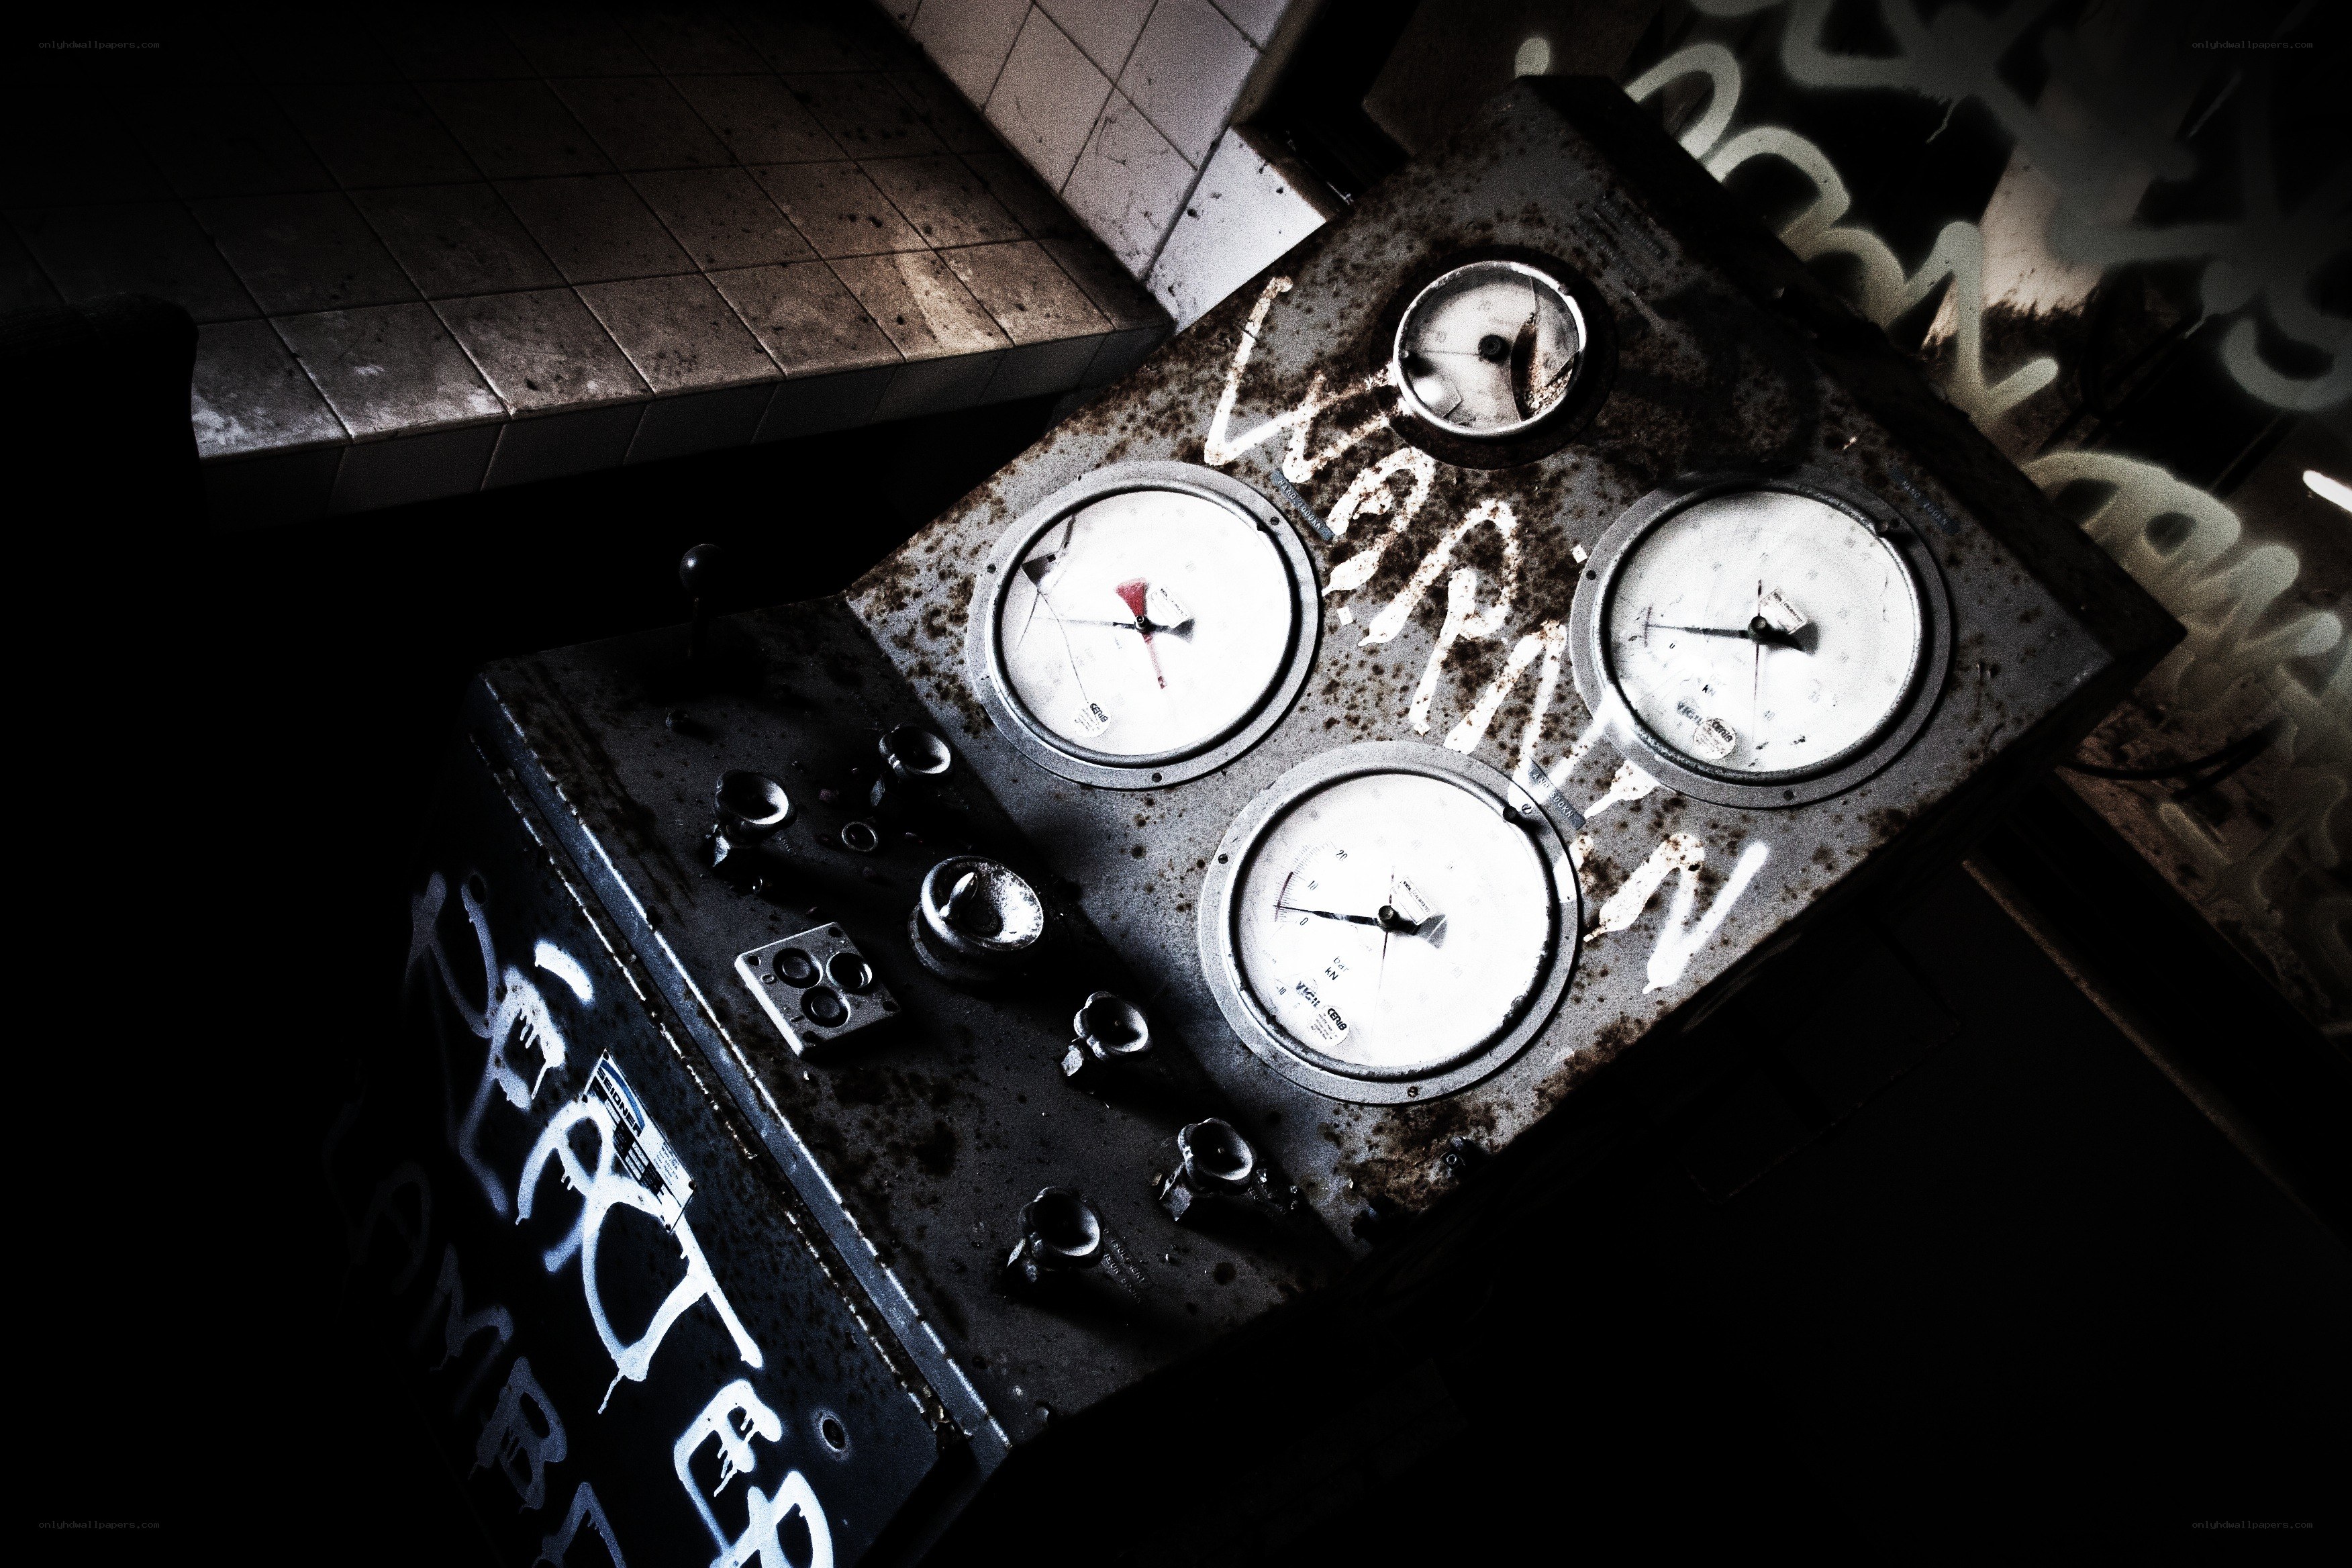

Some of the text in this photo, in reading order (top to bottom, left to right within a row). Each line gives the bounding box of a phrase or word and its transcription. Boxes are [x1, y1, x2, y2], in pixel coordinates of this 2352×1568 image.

[1335, 848, 1349, 862] 20
[1308, 879, 1319, 891] 10
[1327, 1008, 1348, 1031] CERIB
[596, 1066, 643, 1138] SEIDNER
